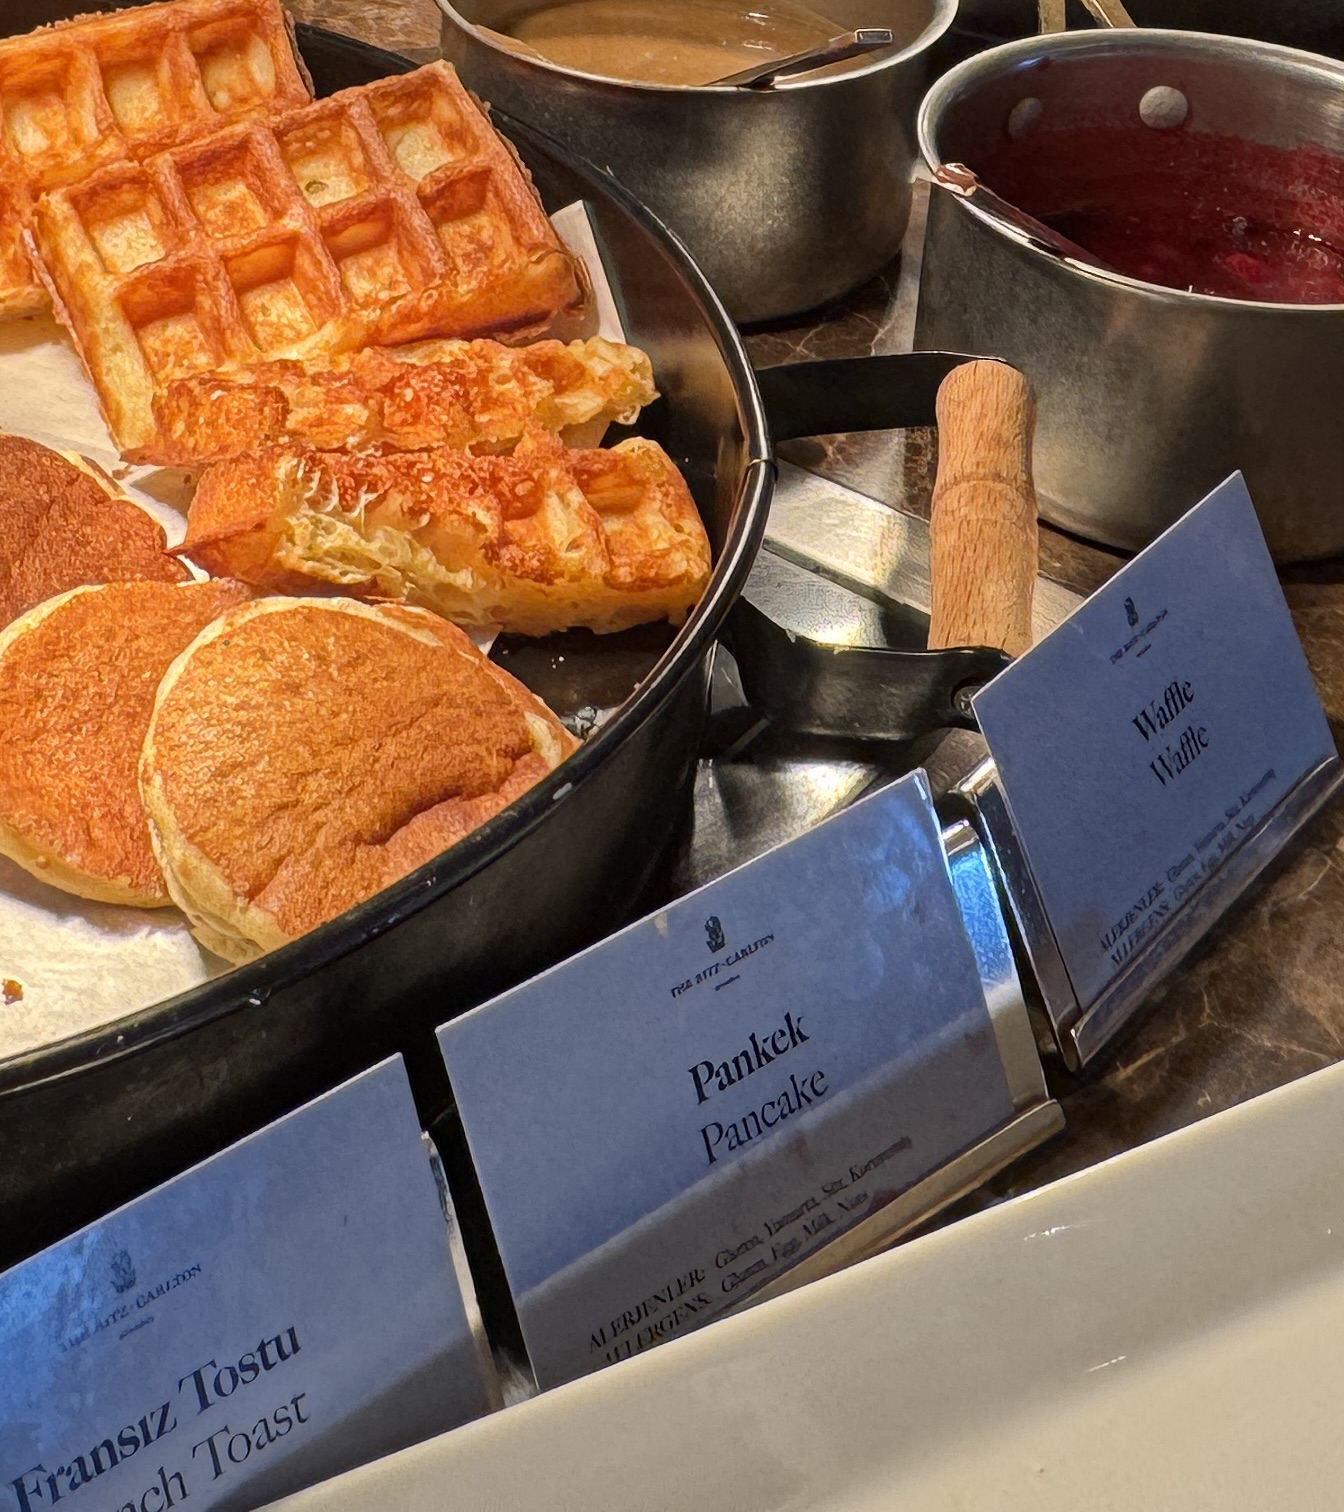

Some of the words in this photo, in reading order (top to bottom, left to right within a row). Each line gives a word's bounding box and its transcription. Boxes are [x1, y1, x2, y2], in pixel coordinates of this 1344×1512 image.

[1132, 681, 1194, 742] Waffle
[1150, 725, 1209, 786] Waffle
[686, 1011, 810, 1104] Pankek
[699, 1066, 829, 1165] Pancake
[9, 1401, 177, 1512] Fransız
[178, 1326, 302, 1415] Tostu
[191, 1393, 309, 1481] Toast
